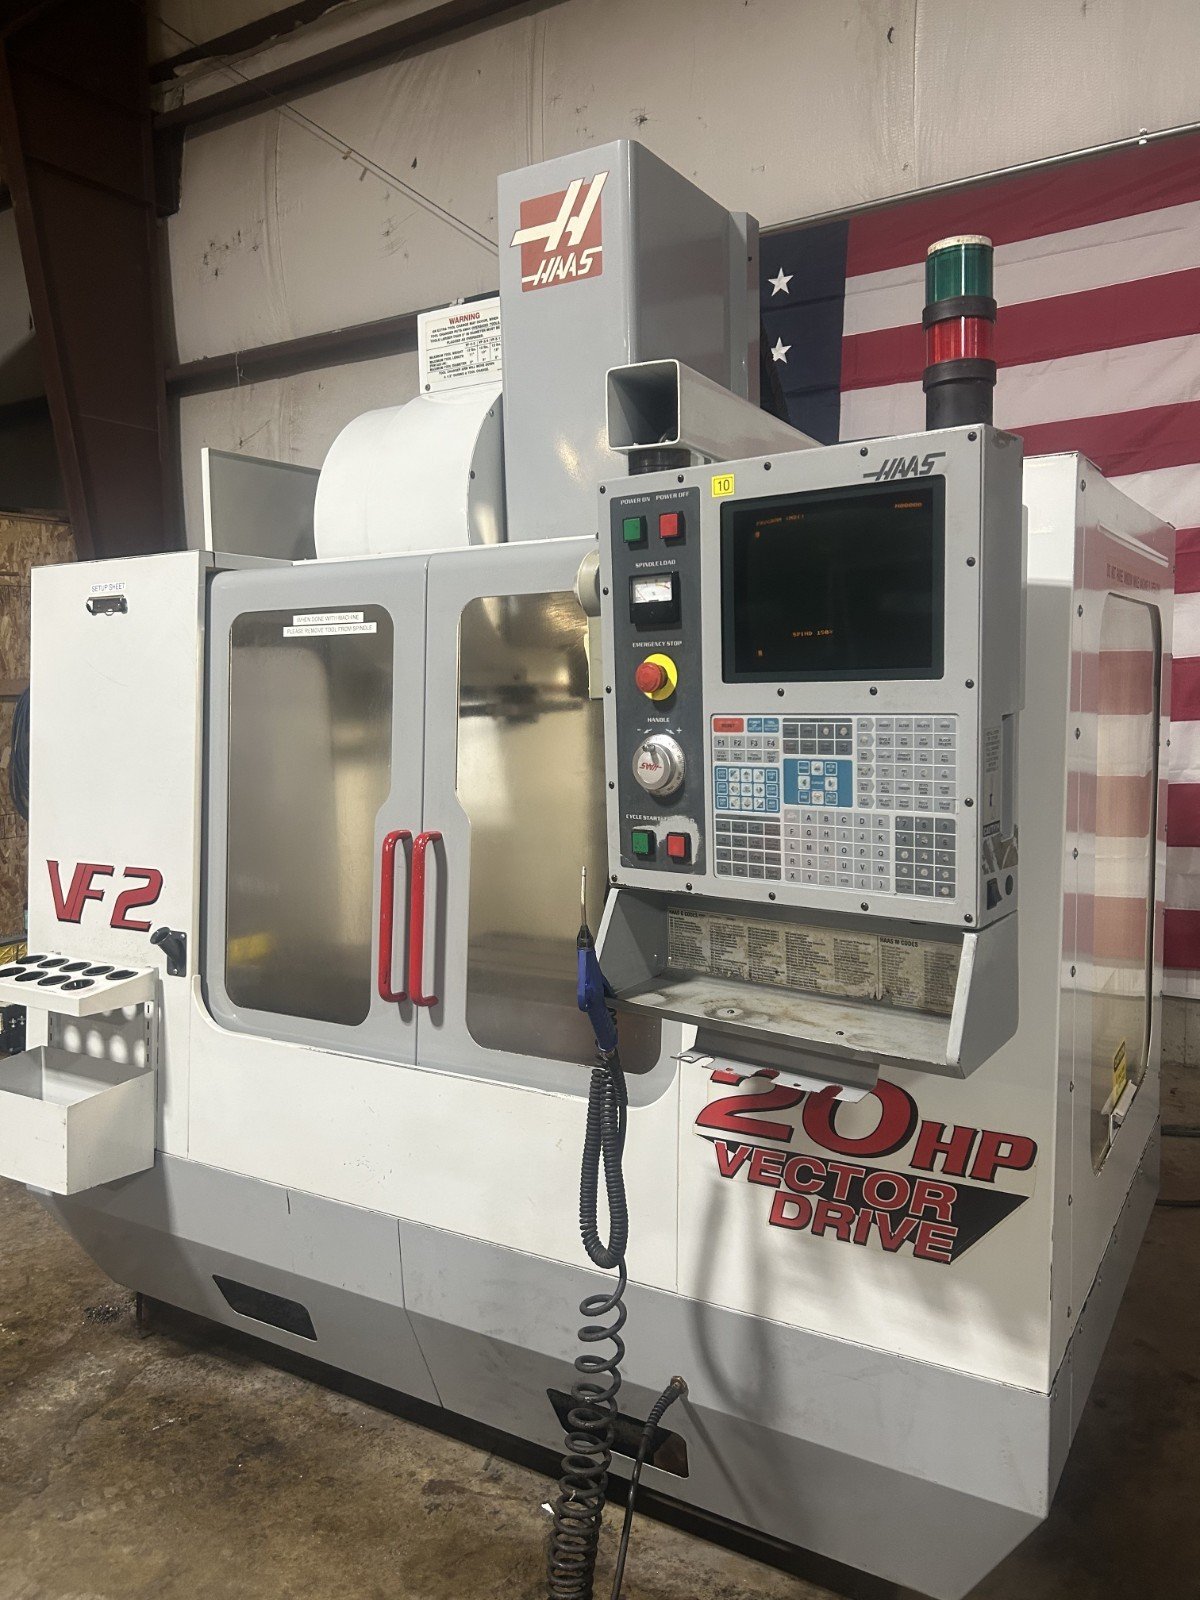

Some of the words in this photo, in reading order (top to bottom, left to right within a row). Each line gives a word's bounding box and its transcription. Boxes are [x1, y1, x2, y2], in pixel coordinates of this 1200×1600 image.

[522, 246, 602, 285] HAAS
[449, 312, 480, 324] WARNING
[863, 452, 946, 481] HAAS
[718, 479, 730, 491] 10
[91, 584, 108, 592] SETUP
[46, 859, 165, 933] VF2
[901, 940, 919, 948] CODES
[713, 1140, 958, 1222] VECTOR
[769, 1190, 959, 1265] DRIVE
